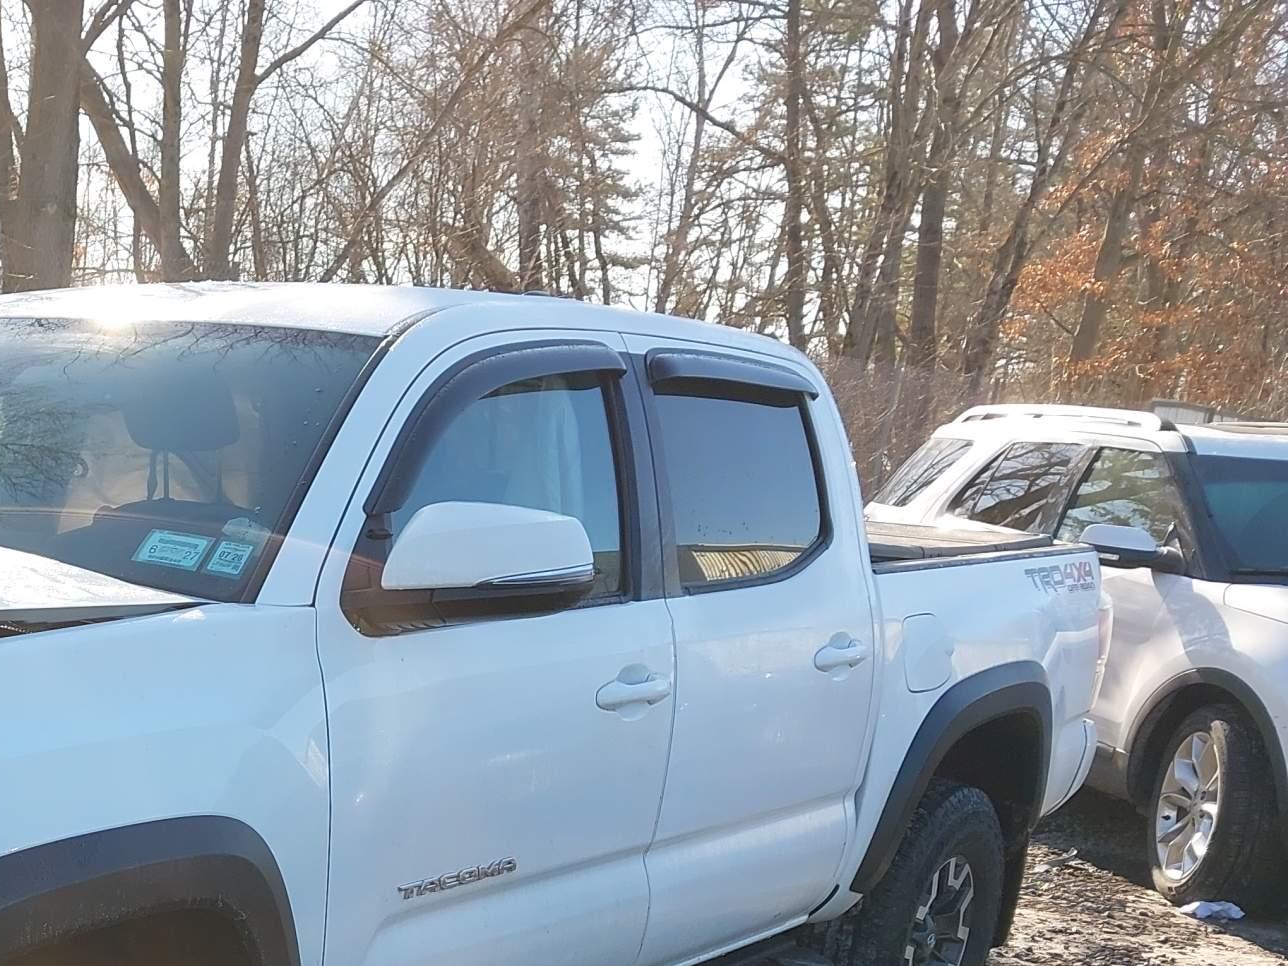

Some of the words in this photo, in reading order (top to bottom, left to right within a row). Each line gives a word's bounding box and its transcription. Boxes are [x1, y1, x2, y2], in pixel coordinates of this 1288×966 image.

[149, 545, 158, 554] 6
[184, 551, 200, 560] 27
[1024, 565, 1065, 593] TRD
[397, 856, 517, 899] TACOMA
